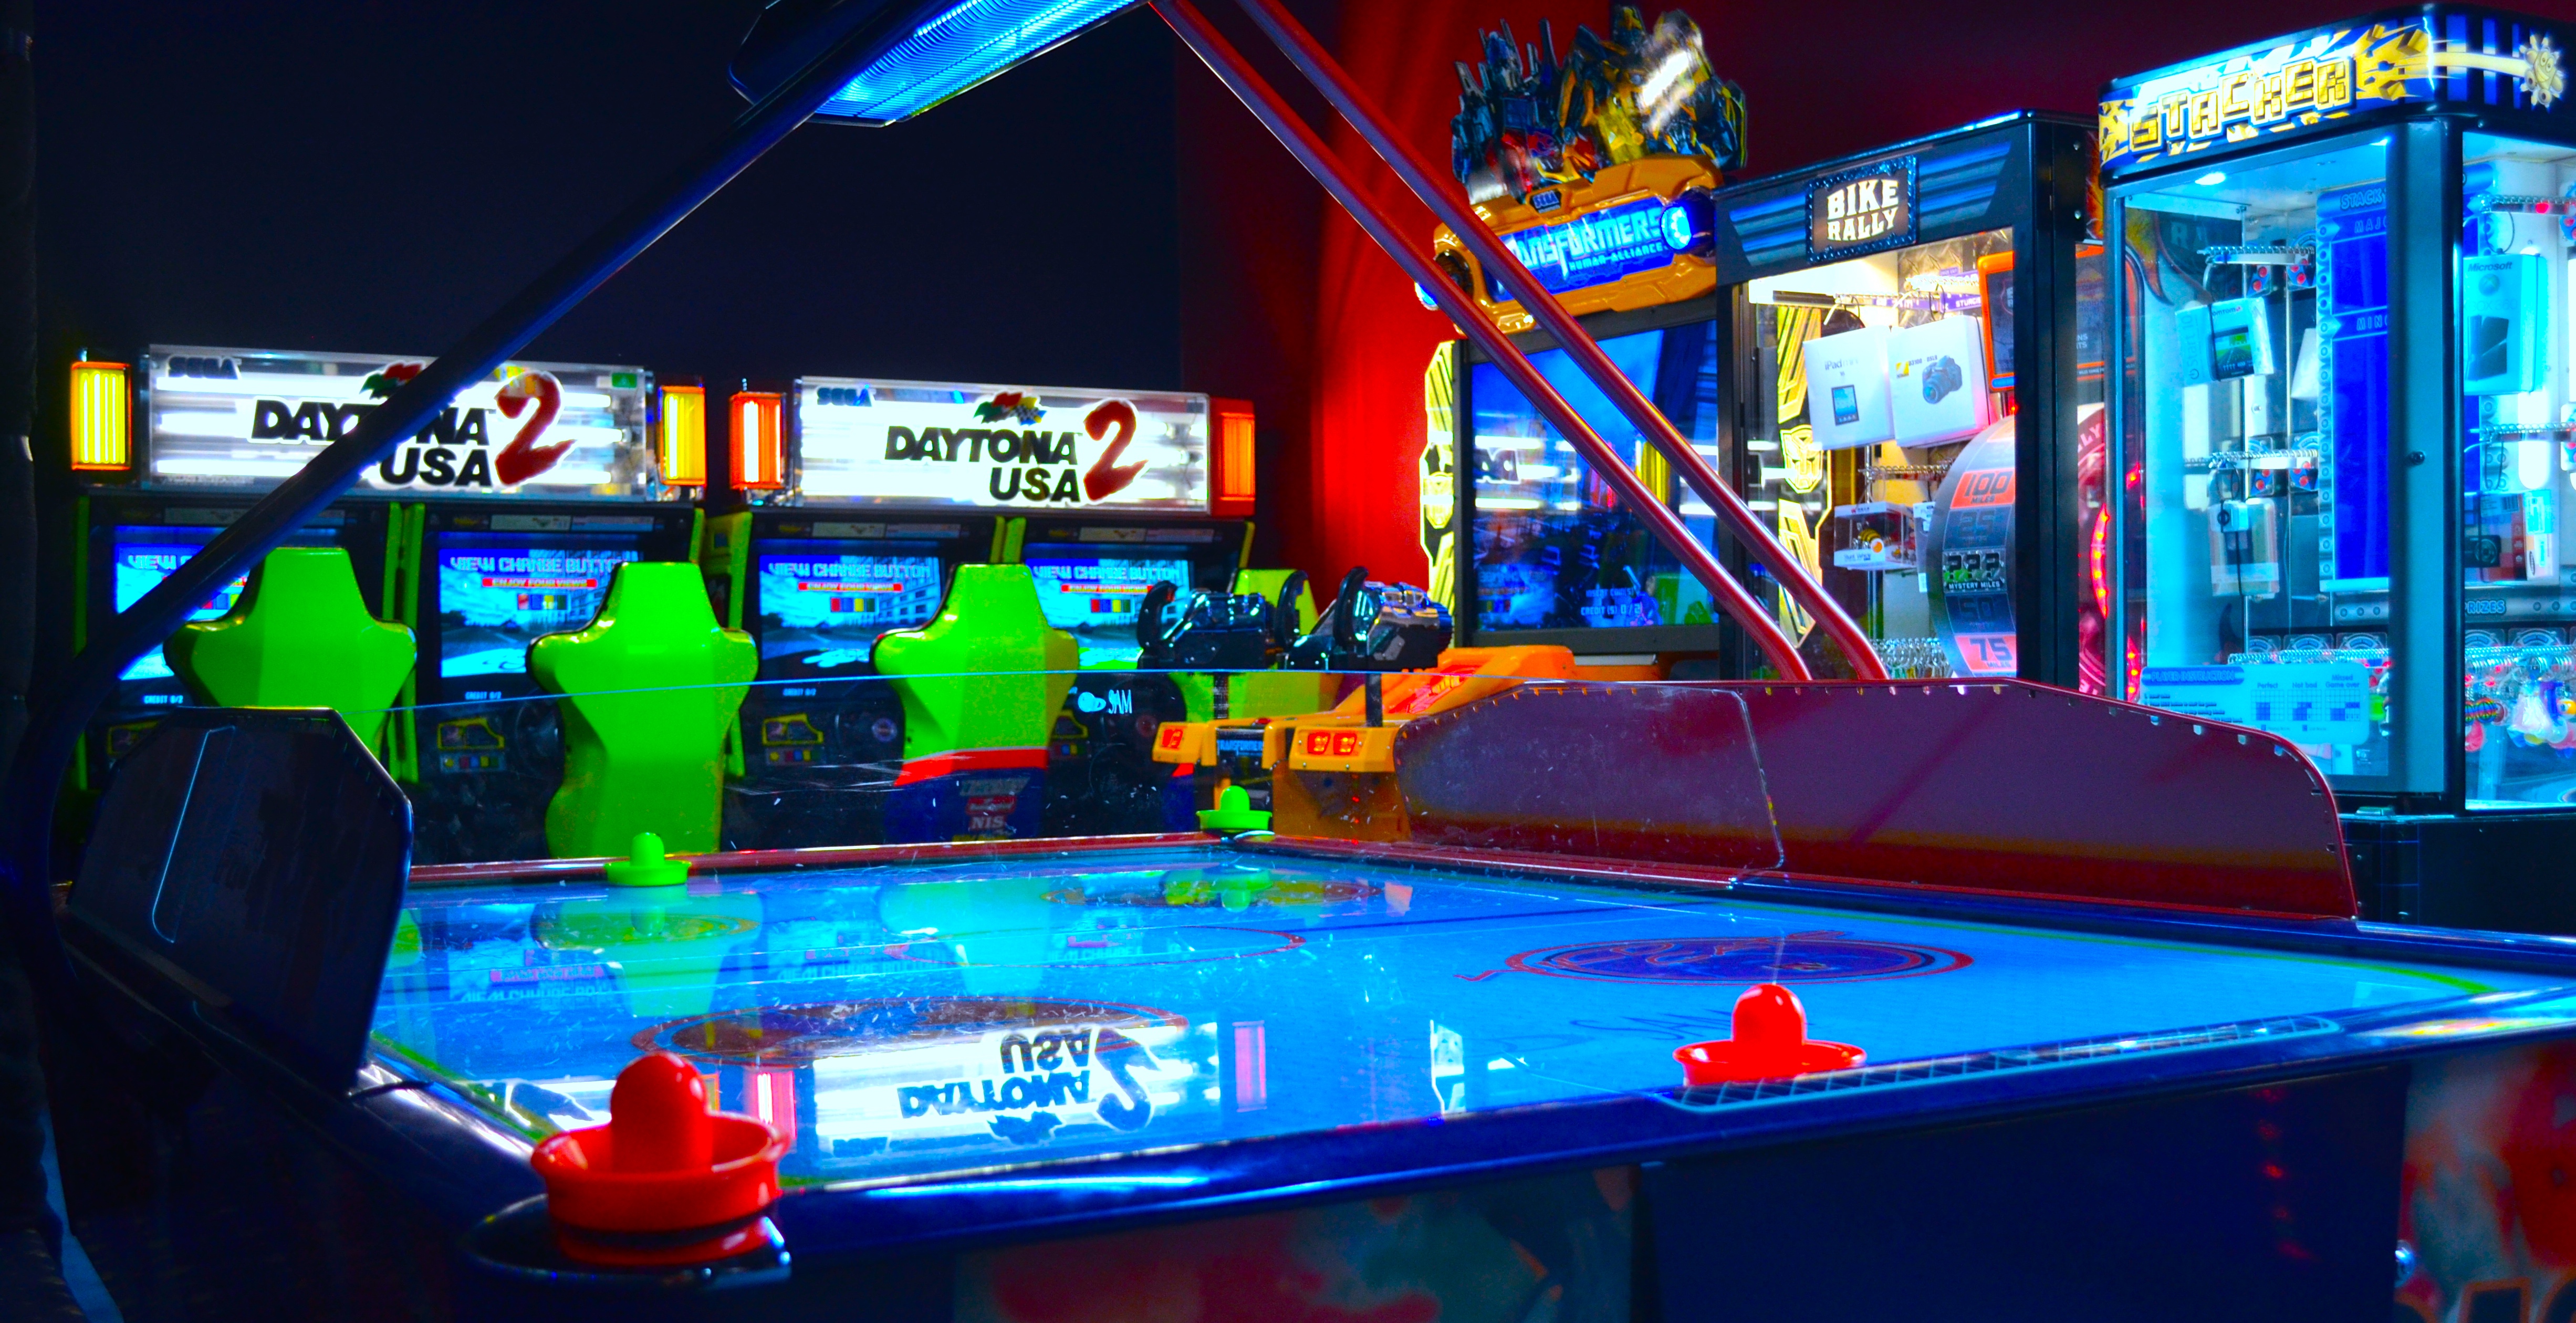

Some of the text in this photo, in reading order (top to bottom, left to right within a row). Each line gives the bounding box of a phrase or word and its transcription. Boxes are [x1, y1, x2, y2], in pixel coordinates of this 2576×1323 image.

[2131, 60, 2346, 148] STACKER
[1827, 179, 1899, 221] BIKE
[2340, 187, 2386, 210] STACK
[1827, 207, 1899, 241] RALLY
[2354, 216, 2386, 234] MAJ
[2467, 261, 2512, 272] Microsoft
[2356, 314, 2387, 331] MIN
[1824, 359, 1842, 370] iPad
[494, 371, 578, 486] 2
[884, 425, 1078, 466] DAYTONA
[1083, 400, 1150, 502] 2
[380, 446, 493, 487] USA
[989, 467, 1081, 503] USA
[1963, 471, 2014, 497] 100
[1970, 495, 1995, 504] MILES
[128, 555, 177, 570] VIEW
[450, 556, 496, 571] VIEW
[498, 557, 562, 573] CHANGE
[768, 562, 931, 578] VIEW CHANGE BUTTON
[1033, 565, 1072, 579] VIEW
[1074, 566, 1128, 579] CHANGE
[2464, 600, 2506, 614] RIZES
[1968, 637, 2013, 662] 75
[2151, 671, 2179, 682] PLAYER
